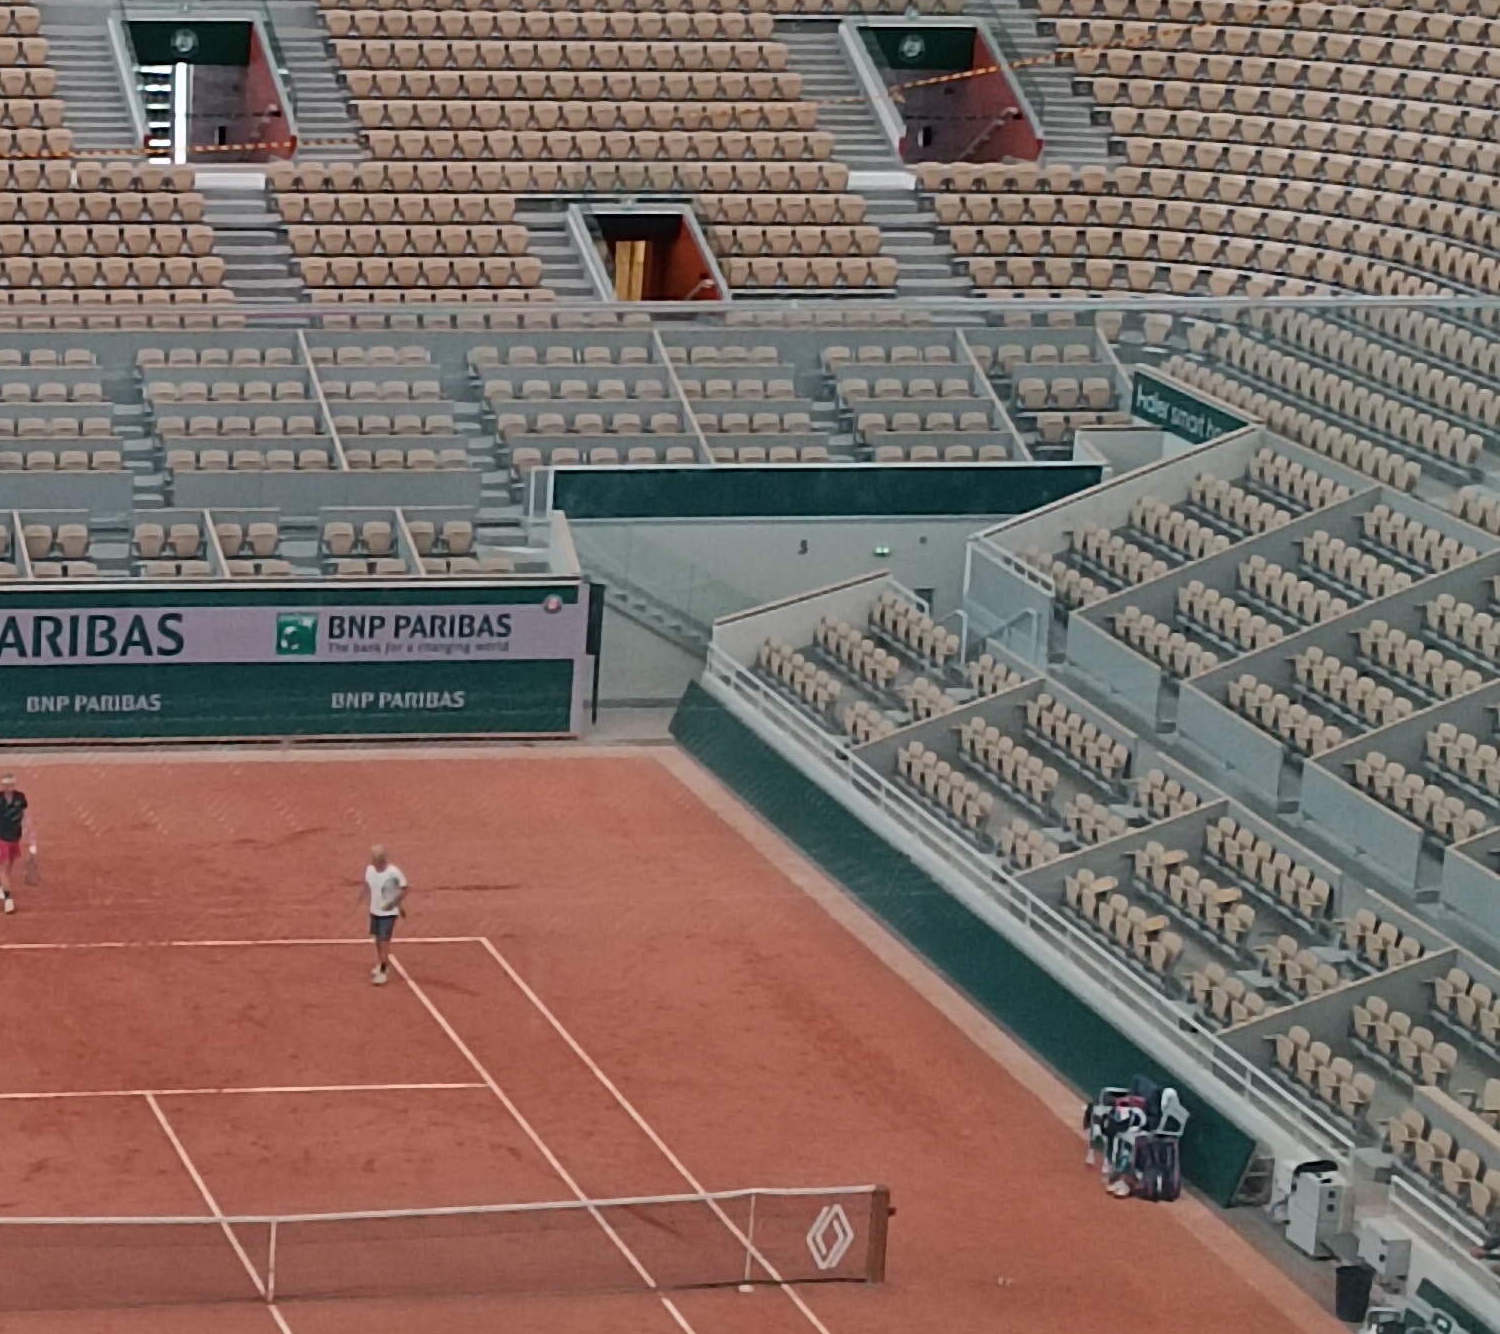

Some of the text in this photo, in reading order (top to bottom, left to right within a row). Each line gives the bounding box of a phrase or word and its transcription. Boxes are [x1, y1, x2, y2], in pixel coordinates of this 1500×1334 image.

[328, 612, 513, 640] BNP PARIBAS
[26, 693, 162, 713] BNP PARIBAS
[331, 690, 467, 710] BNP PARIBAS
